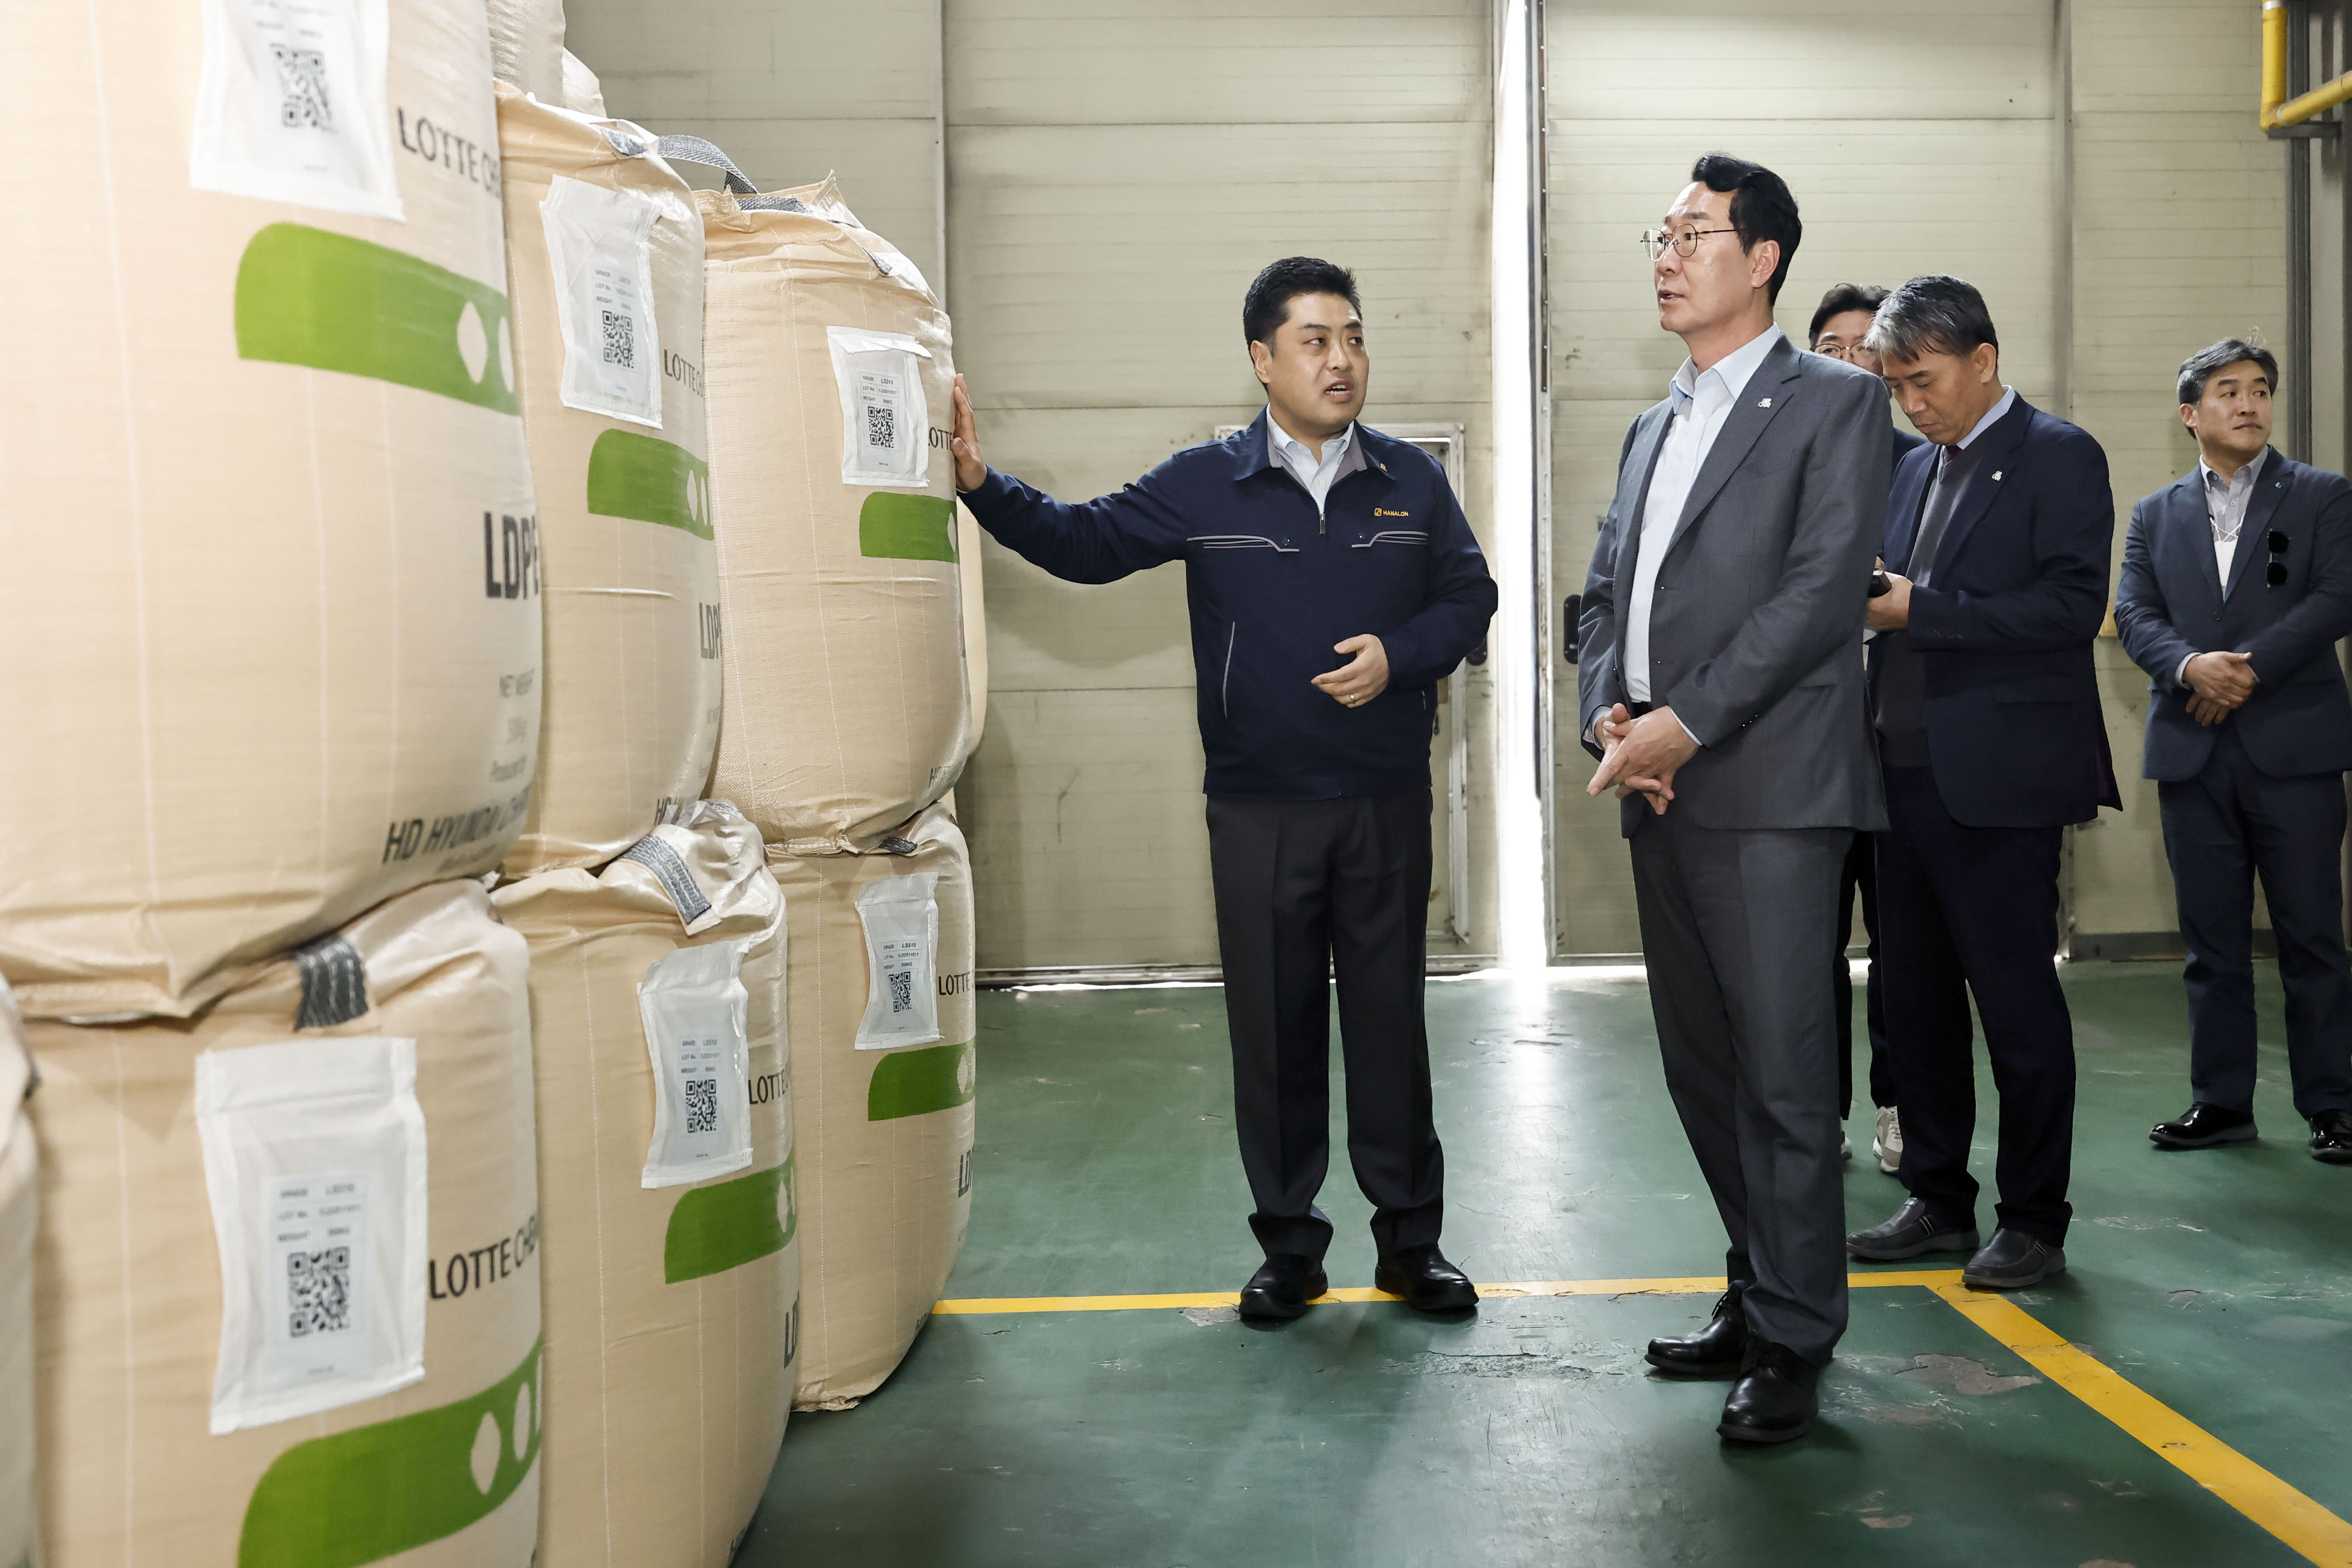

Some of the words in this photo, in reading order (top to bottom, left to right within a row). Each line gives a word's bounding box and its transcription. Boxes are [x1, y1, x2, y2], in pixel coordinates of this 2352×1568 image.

[397, 106, 479, 183] LOTTE
[664, 348, 696, 392] LOTTE
[929, 426, 953, 451] OTTE
[382, 819, 423, 864] HD
[938, 972, 970, 995] LOTTE
[748, 1069, 785, 1104] LOTTE
[430, 1237, 510, 1299] LOTTE
